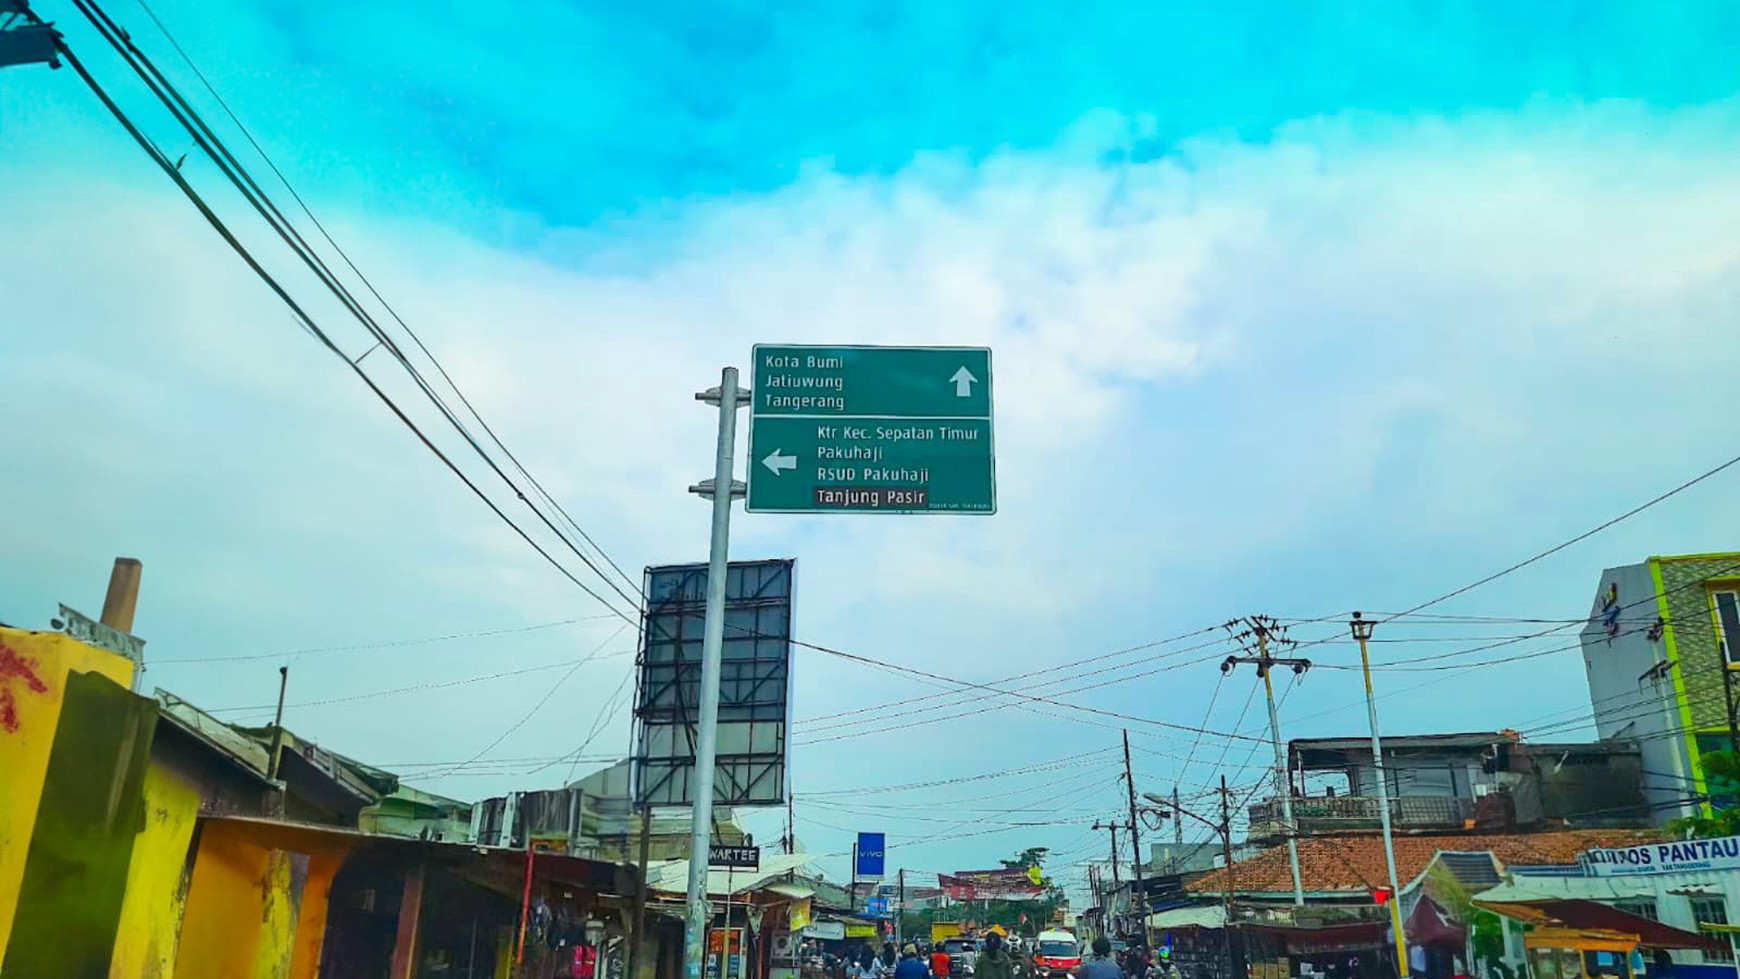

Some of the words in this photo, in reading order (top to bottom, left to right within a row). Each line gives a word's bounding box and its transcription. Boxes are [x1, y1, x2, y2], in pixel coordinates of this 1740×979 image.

[766, 356, 799, 368] Kota
[807, 356, 844, 368] Bumi
[766, 375, 844, 391] Jatiuwung
[765, 395, 844, 410] Tangerang
[818, 427, 838, 440] Ktr
[844, 427, 871, 440] Kec.
[877, 427, 933, 442] Sepatan
[939, 427, 979, 440] Timur
[818, 447, 882, 462] Pakuhaji
[818, 468, 856, 481] RSUD
[864, 468, 929, 484] Pakuhaji
[817, 490, 879, 506] Tanjung
[887, 490, 925, 504] Pasir
[1658, 838, 1739, 862] PANTAU
